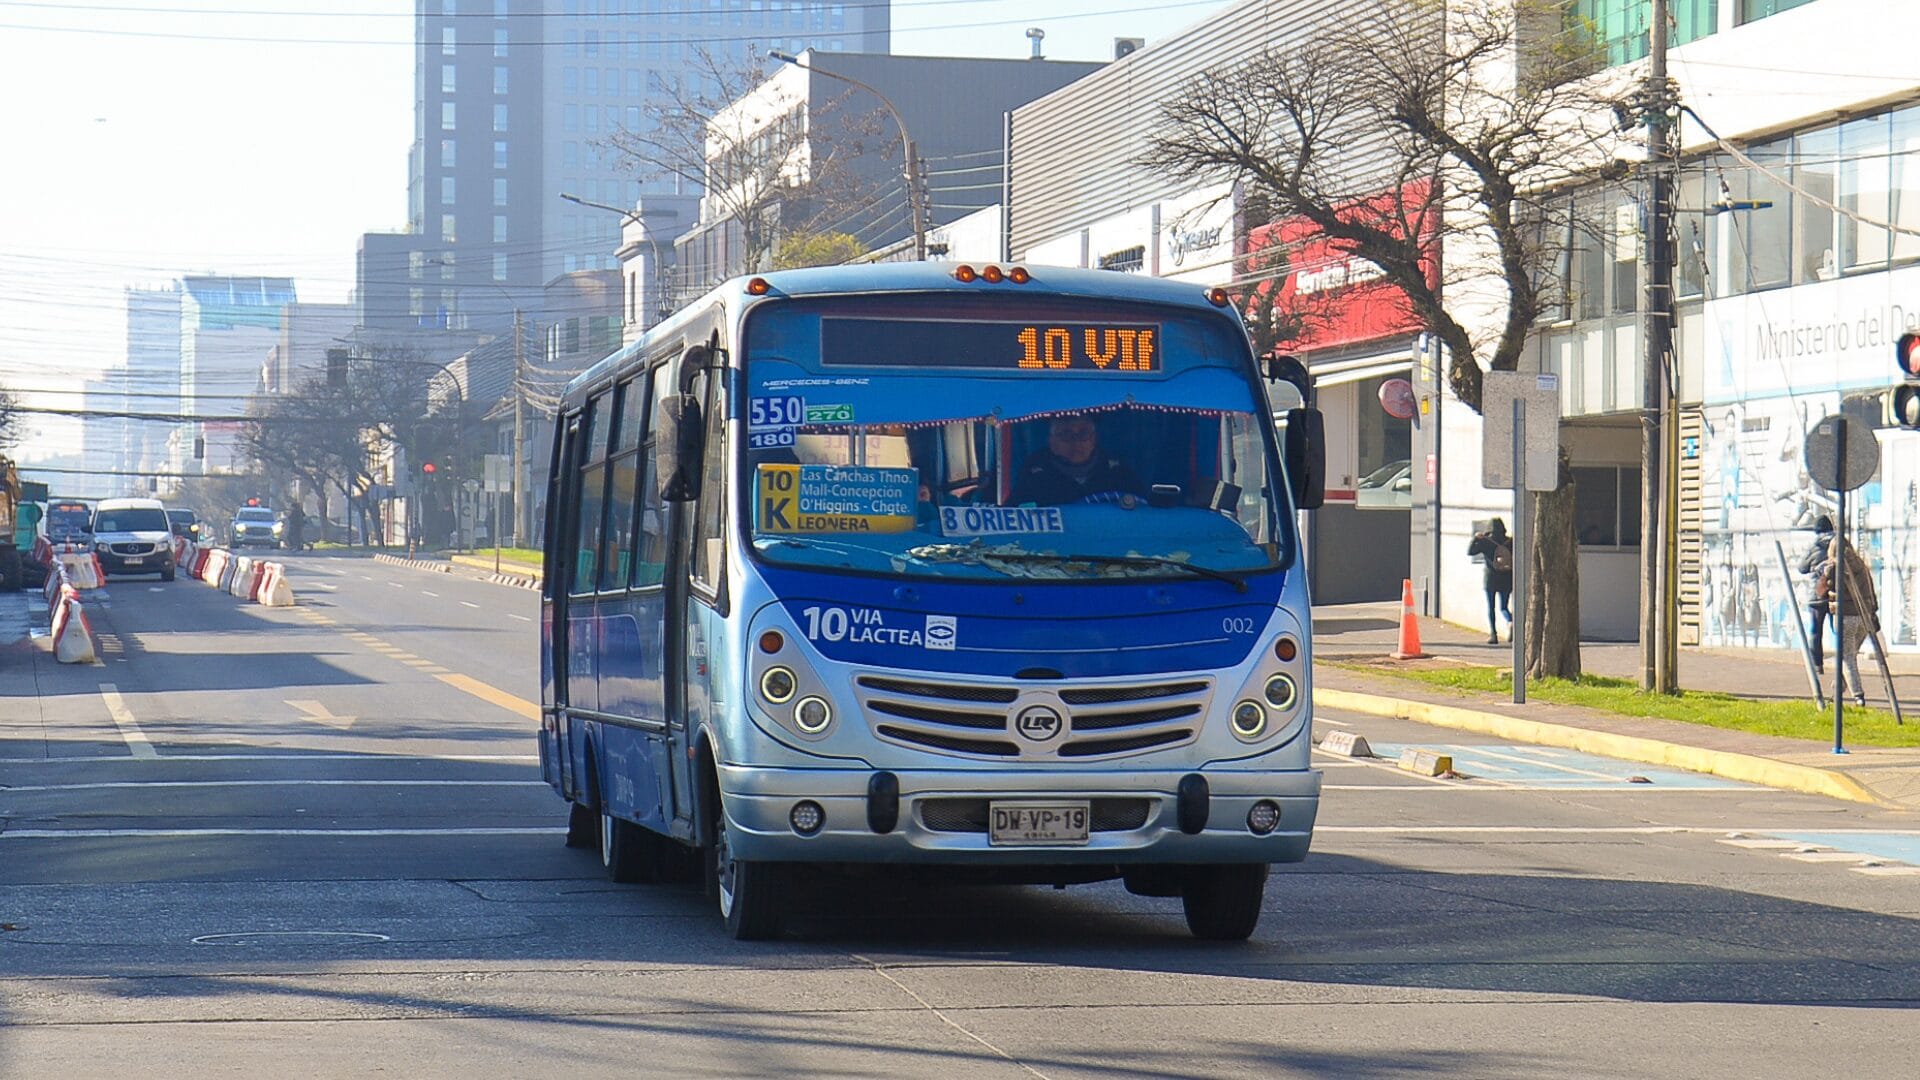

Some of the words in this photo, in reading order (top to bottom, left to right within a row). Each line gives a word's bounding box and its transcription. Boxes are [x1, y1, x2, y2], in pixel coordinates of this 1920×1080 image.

[1757, 313, 1849, 360] Ministerio
[1856, 306, 1886, 349] del
[1891, 305, 1920, 343] De
[1018, 328, 1071, 369] 10
[762, 379, 870, 387] MERCEDES-BENZ
[751, 397, 801, 424] 550
[809, 410, 851, 421] 270
[751, 433, 793, 447] 180
[763, 471, 793, 491] 10
[801, 469, 821, 481] Las
[825, 471, 875, 483] Canchas
[801, 484, 902, 499] Mall-Concepción
[765, 498, 791, 530] K
[801, 499, 860, 514] O'Higgins
[871, 500, 911, 515] Chgte.
[797, 517, 870, 531] LEONERA
[944, 507, 958, 531] 8
[965, 508, 1061, 531] ORIENTE
[803, 606, 848, 641] 10
[851, 608, 883, 625] VIA
[1222, 617, 1254, 633] 002
[850, 626, 923, 646] LACTEA
